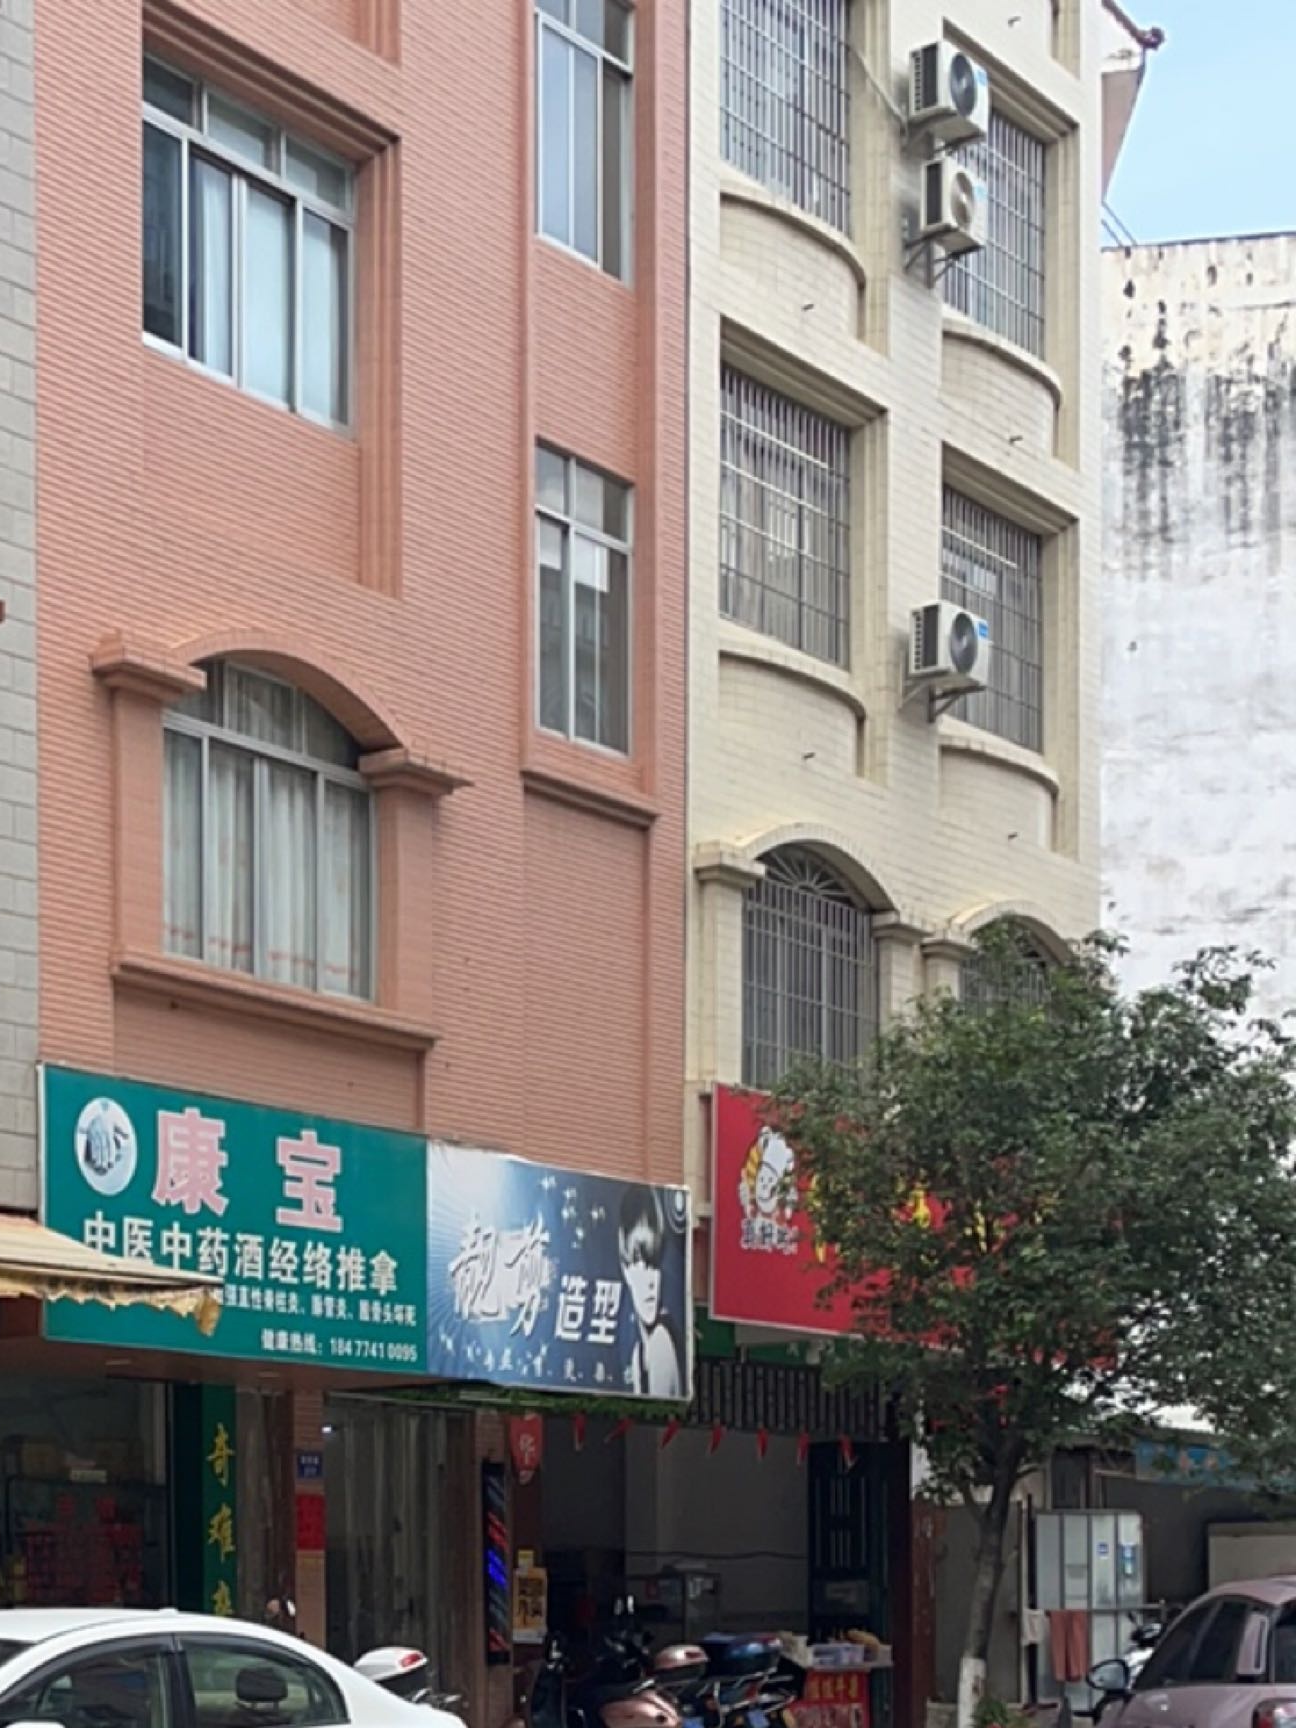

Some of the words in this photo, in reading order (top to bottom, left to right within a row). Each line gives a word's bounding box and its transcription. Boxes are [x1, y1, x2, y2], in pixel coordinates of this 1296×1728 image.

[152, 1107, 342, 1233] 康宝
[83, 1210, 398, 1297] 中医中药酒经络推拿
[555, 1275, 622, 1344] 造型
